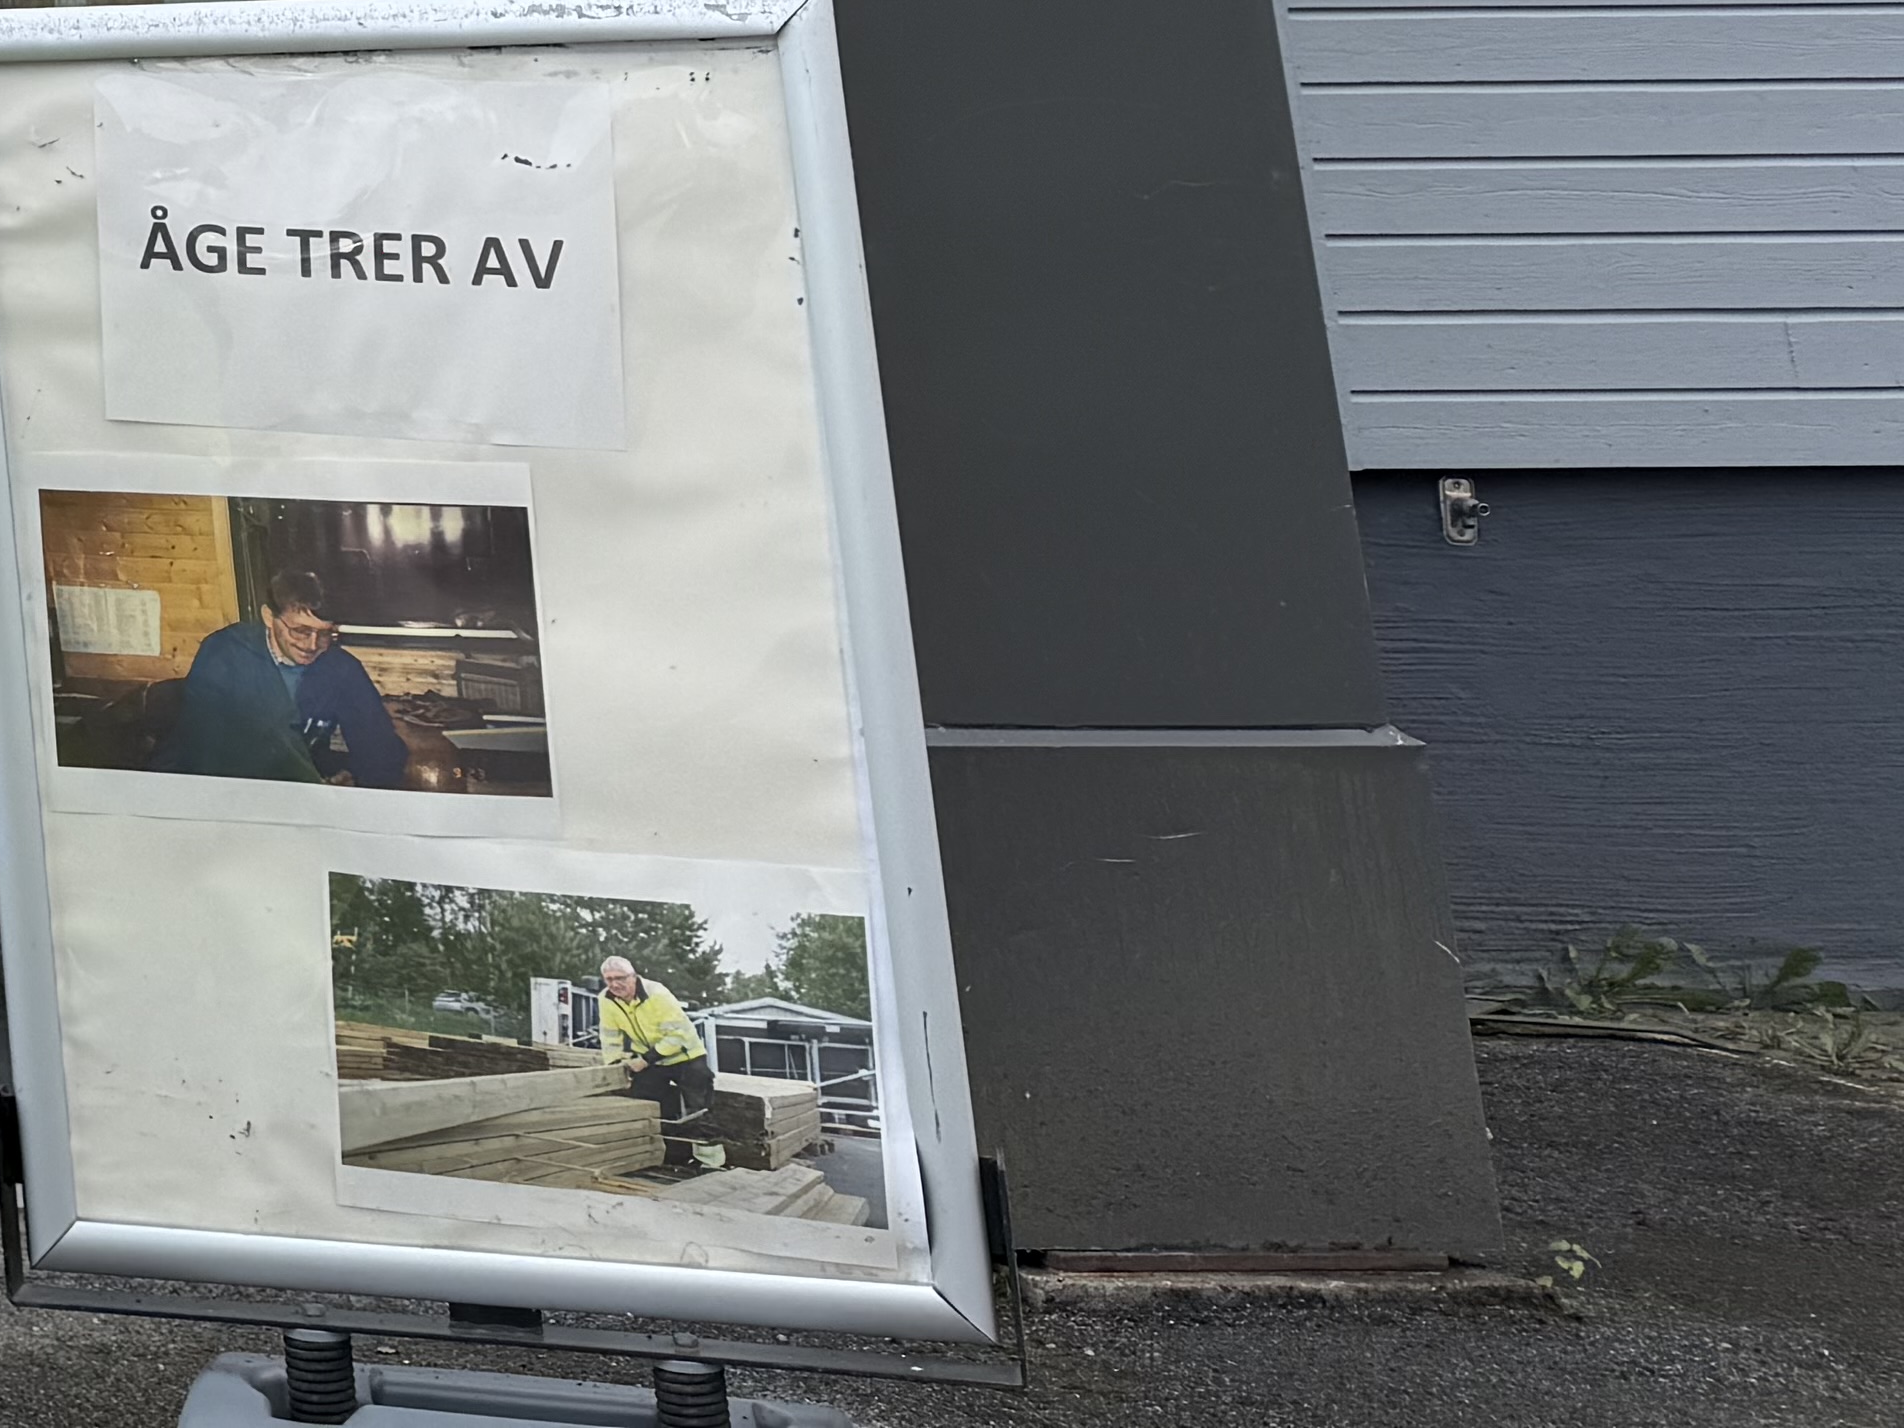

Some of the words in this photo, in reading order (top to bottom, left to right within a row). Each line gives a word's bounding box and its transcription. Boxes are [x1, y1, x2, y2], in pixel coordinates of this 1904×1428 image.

[140, 205, 267, 276] ÅGE
[286, 228, 450, 285] TRER
[471, 237, 564, 289] AV
